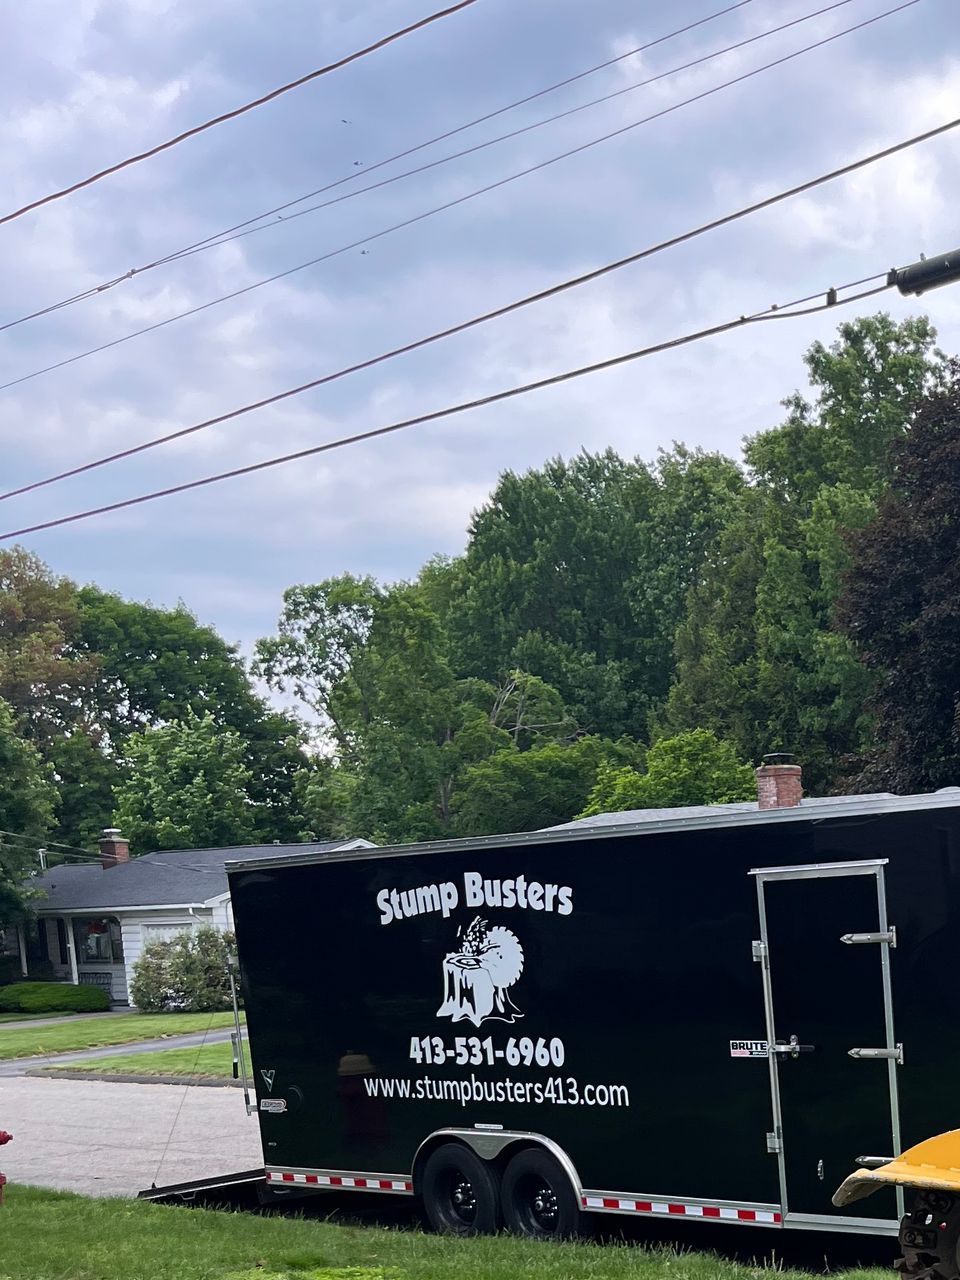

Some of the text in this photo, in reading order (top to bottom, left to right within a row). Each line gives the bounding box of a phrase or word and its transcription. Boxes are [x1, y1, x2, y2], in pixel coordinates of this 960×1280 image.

[376, 872, 574, 925] Stump Busters
[409, 1036, 565, 1067] 413-531-6960
[731, 1042, 767, 1050] BRUTE
[364, 1074, 630, 1107] www.stumpbusters413.com
